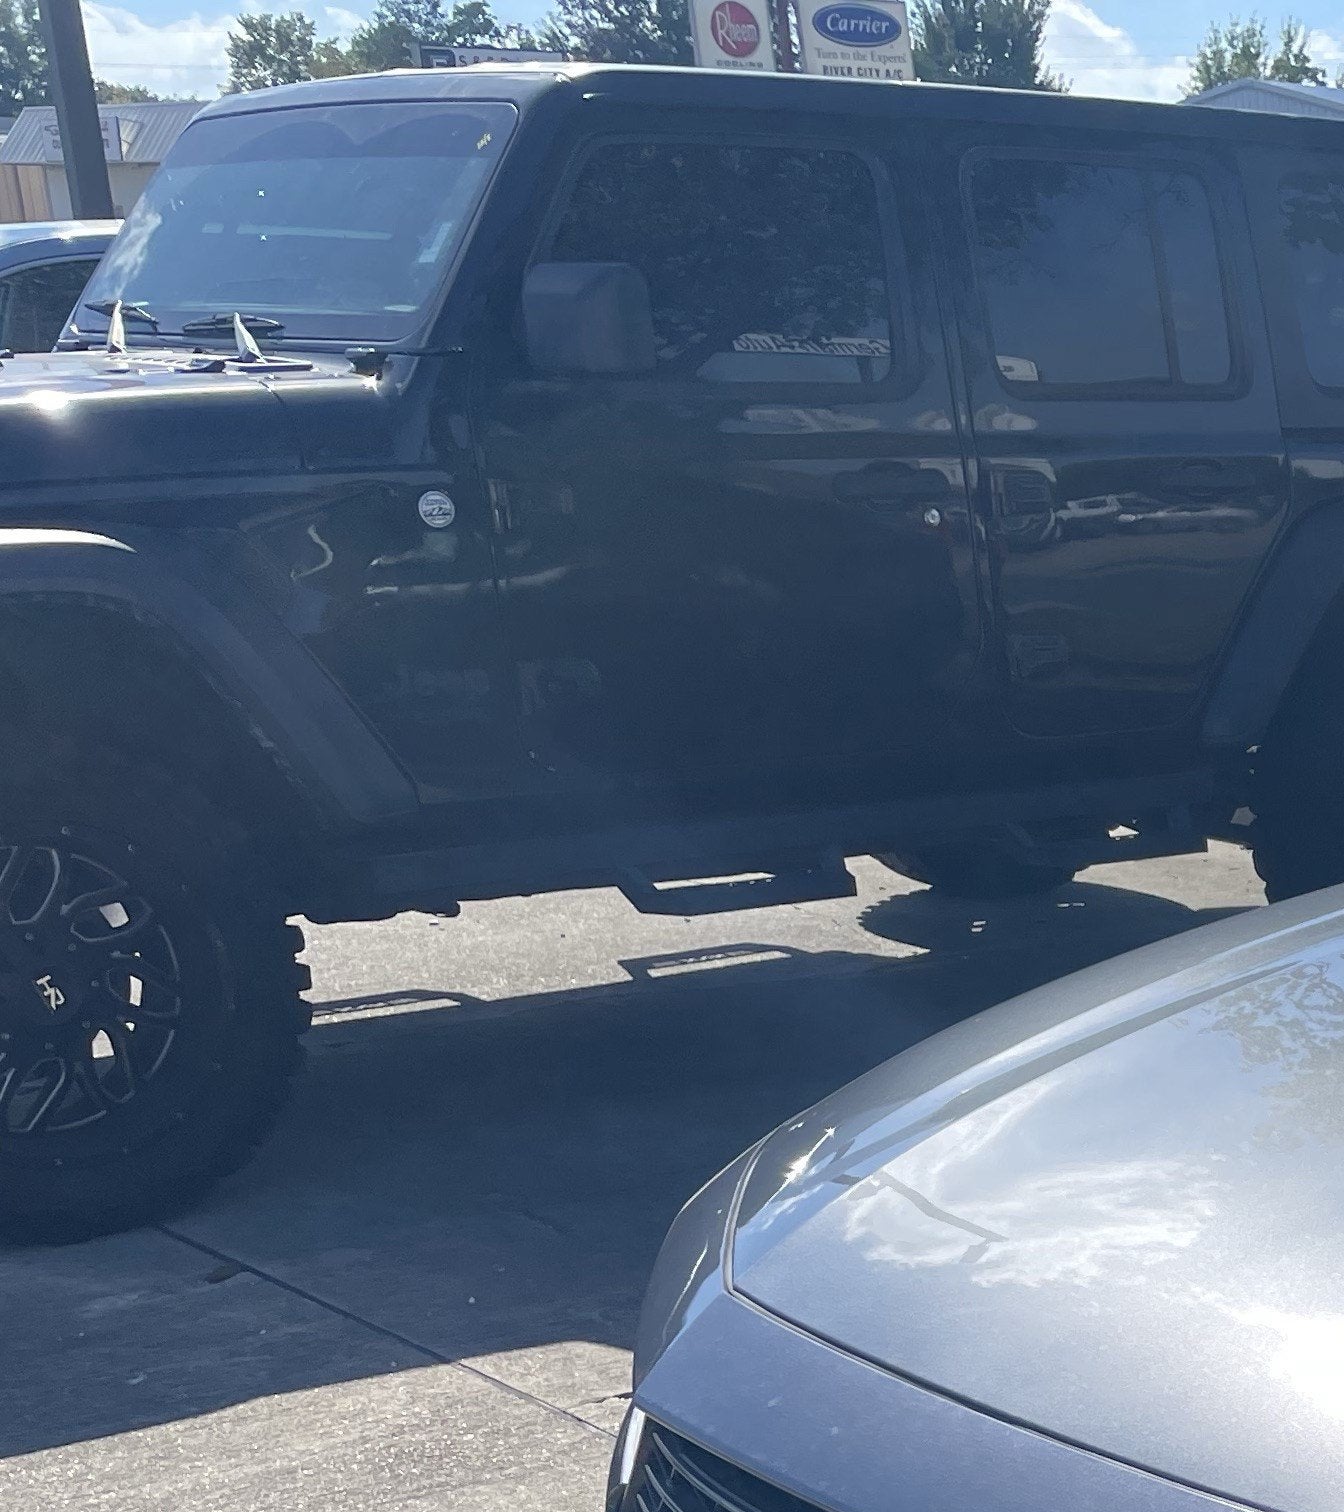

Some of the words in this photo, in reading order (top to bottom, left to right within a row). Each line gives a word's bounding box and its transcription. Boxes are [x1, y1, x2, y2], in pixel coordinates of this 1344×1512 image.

[826, 13, 889, 34] Carrier
[815, 47, 838, 59] Turn
[841, 51, 851, 60] to
[853, 50, 867, 61] the
[822, 65, 853, 77] RIVER
[857, 67, 881, 78] CITY
[885, 68, 904, 80] A/C
